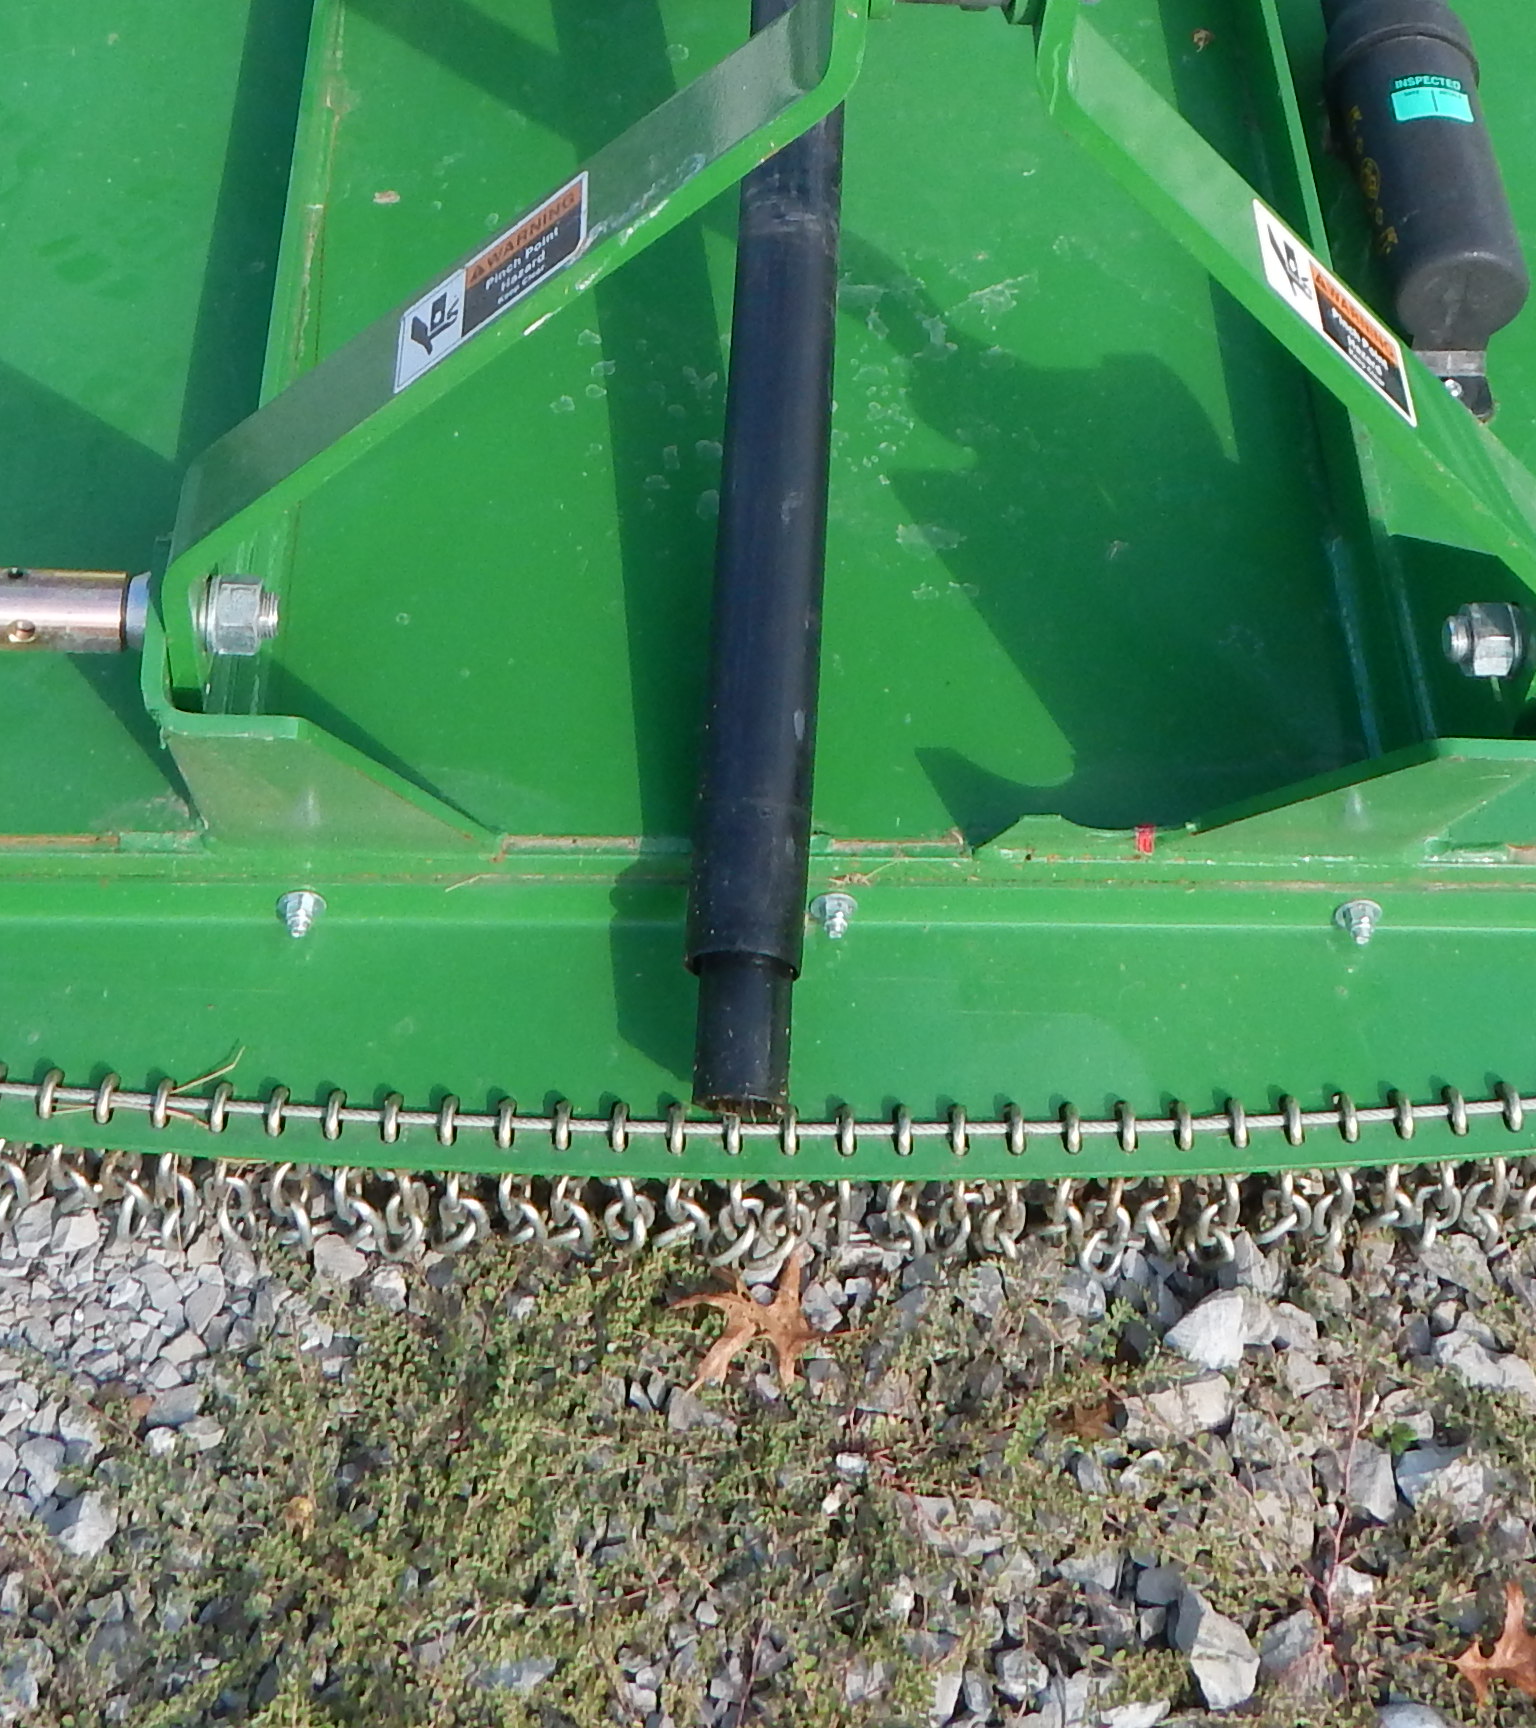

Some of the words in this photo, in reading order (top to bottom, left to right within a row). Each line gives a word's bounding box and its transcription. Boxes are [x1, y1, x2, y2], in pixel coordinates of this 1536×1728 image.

[1394, 75, 1462, 91] INSPECTED
[486, 191, 576, 270] WARNING
[484, 256, 523, 291] Pinch
[524, 226, 560, 260] Point
[500, 249, 546, 292] Hazard
